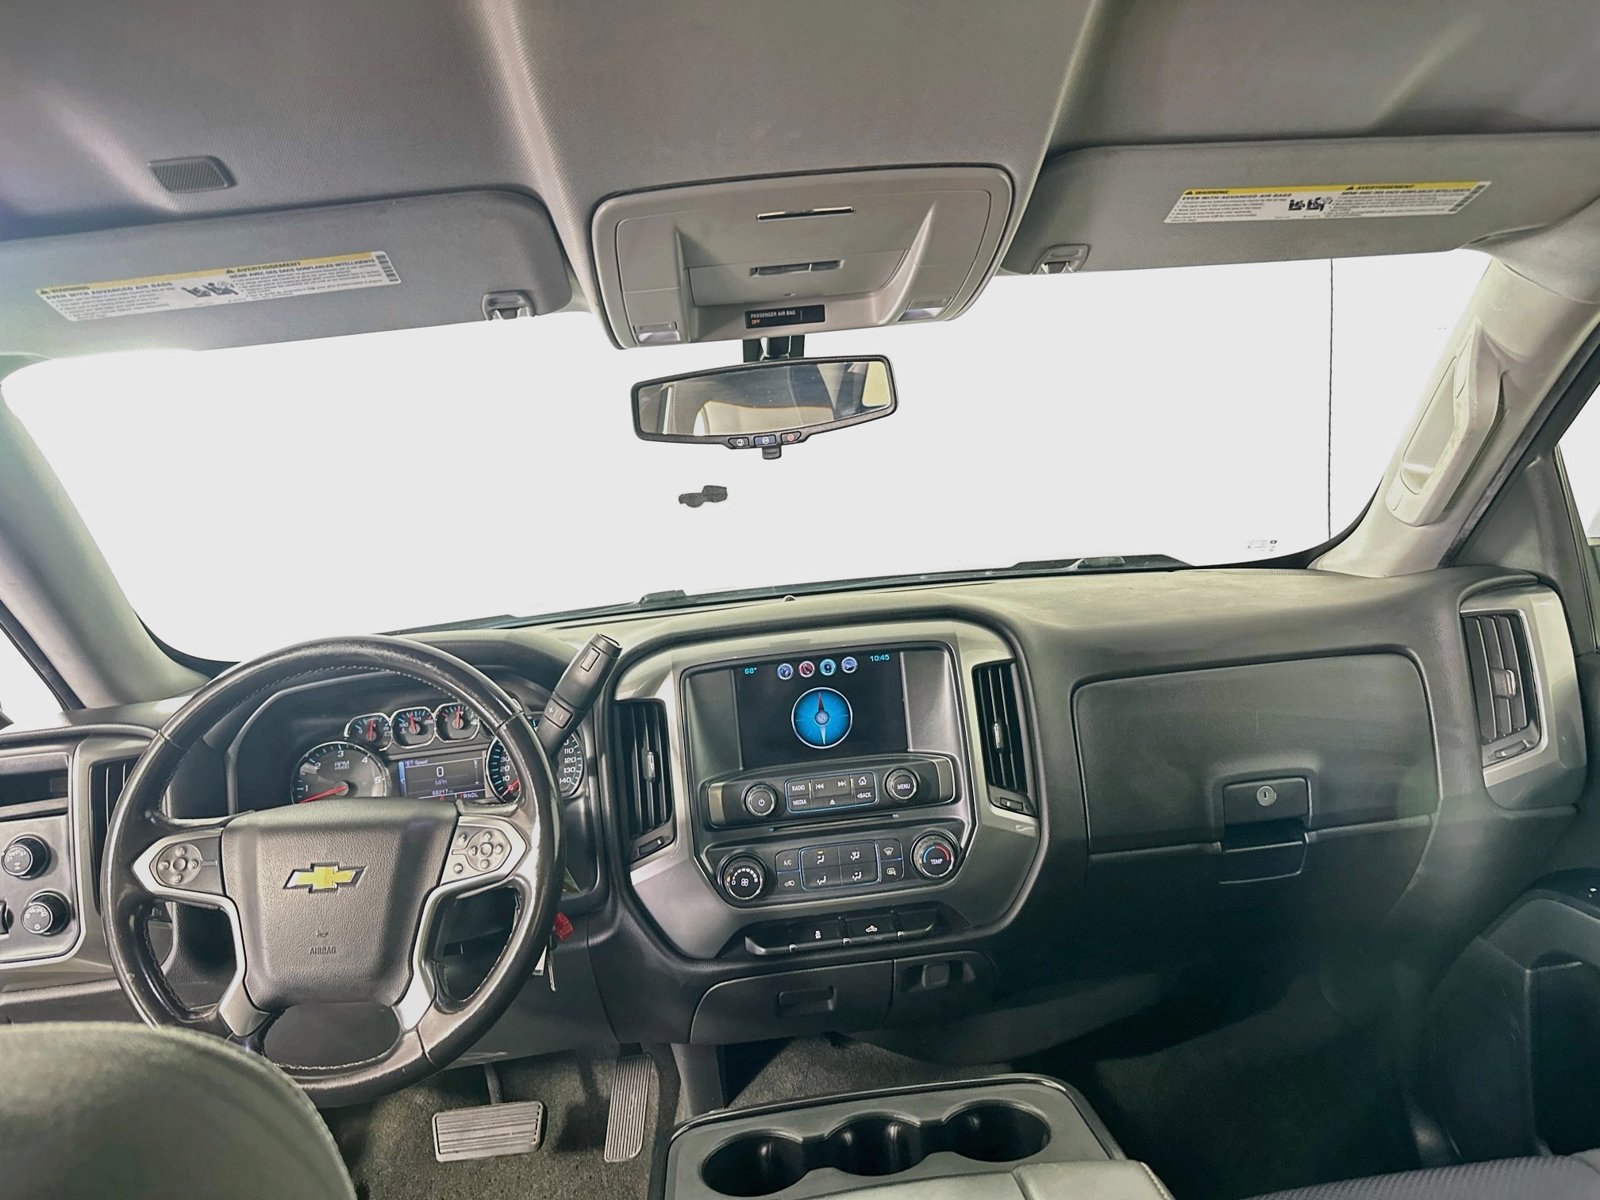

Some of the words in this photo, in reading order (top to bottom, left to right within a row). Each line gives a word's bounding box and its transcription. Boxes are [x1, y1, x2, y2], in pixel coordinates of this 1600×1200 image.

[870, 654, 890, 662] 10:45
[337, 750, 344, 758] 3
[564, 747, 575, 755] 110
[361, 756, 368, 764] 4
[314, 762, 321, 770] 2
[436, 766, 445, 778] 0
[375, 776, 382, 784] 5
[792, 798, 807, 806] MEDIA
